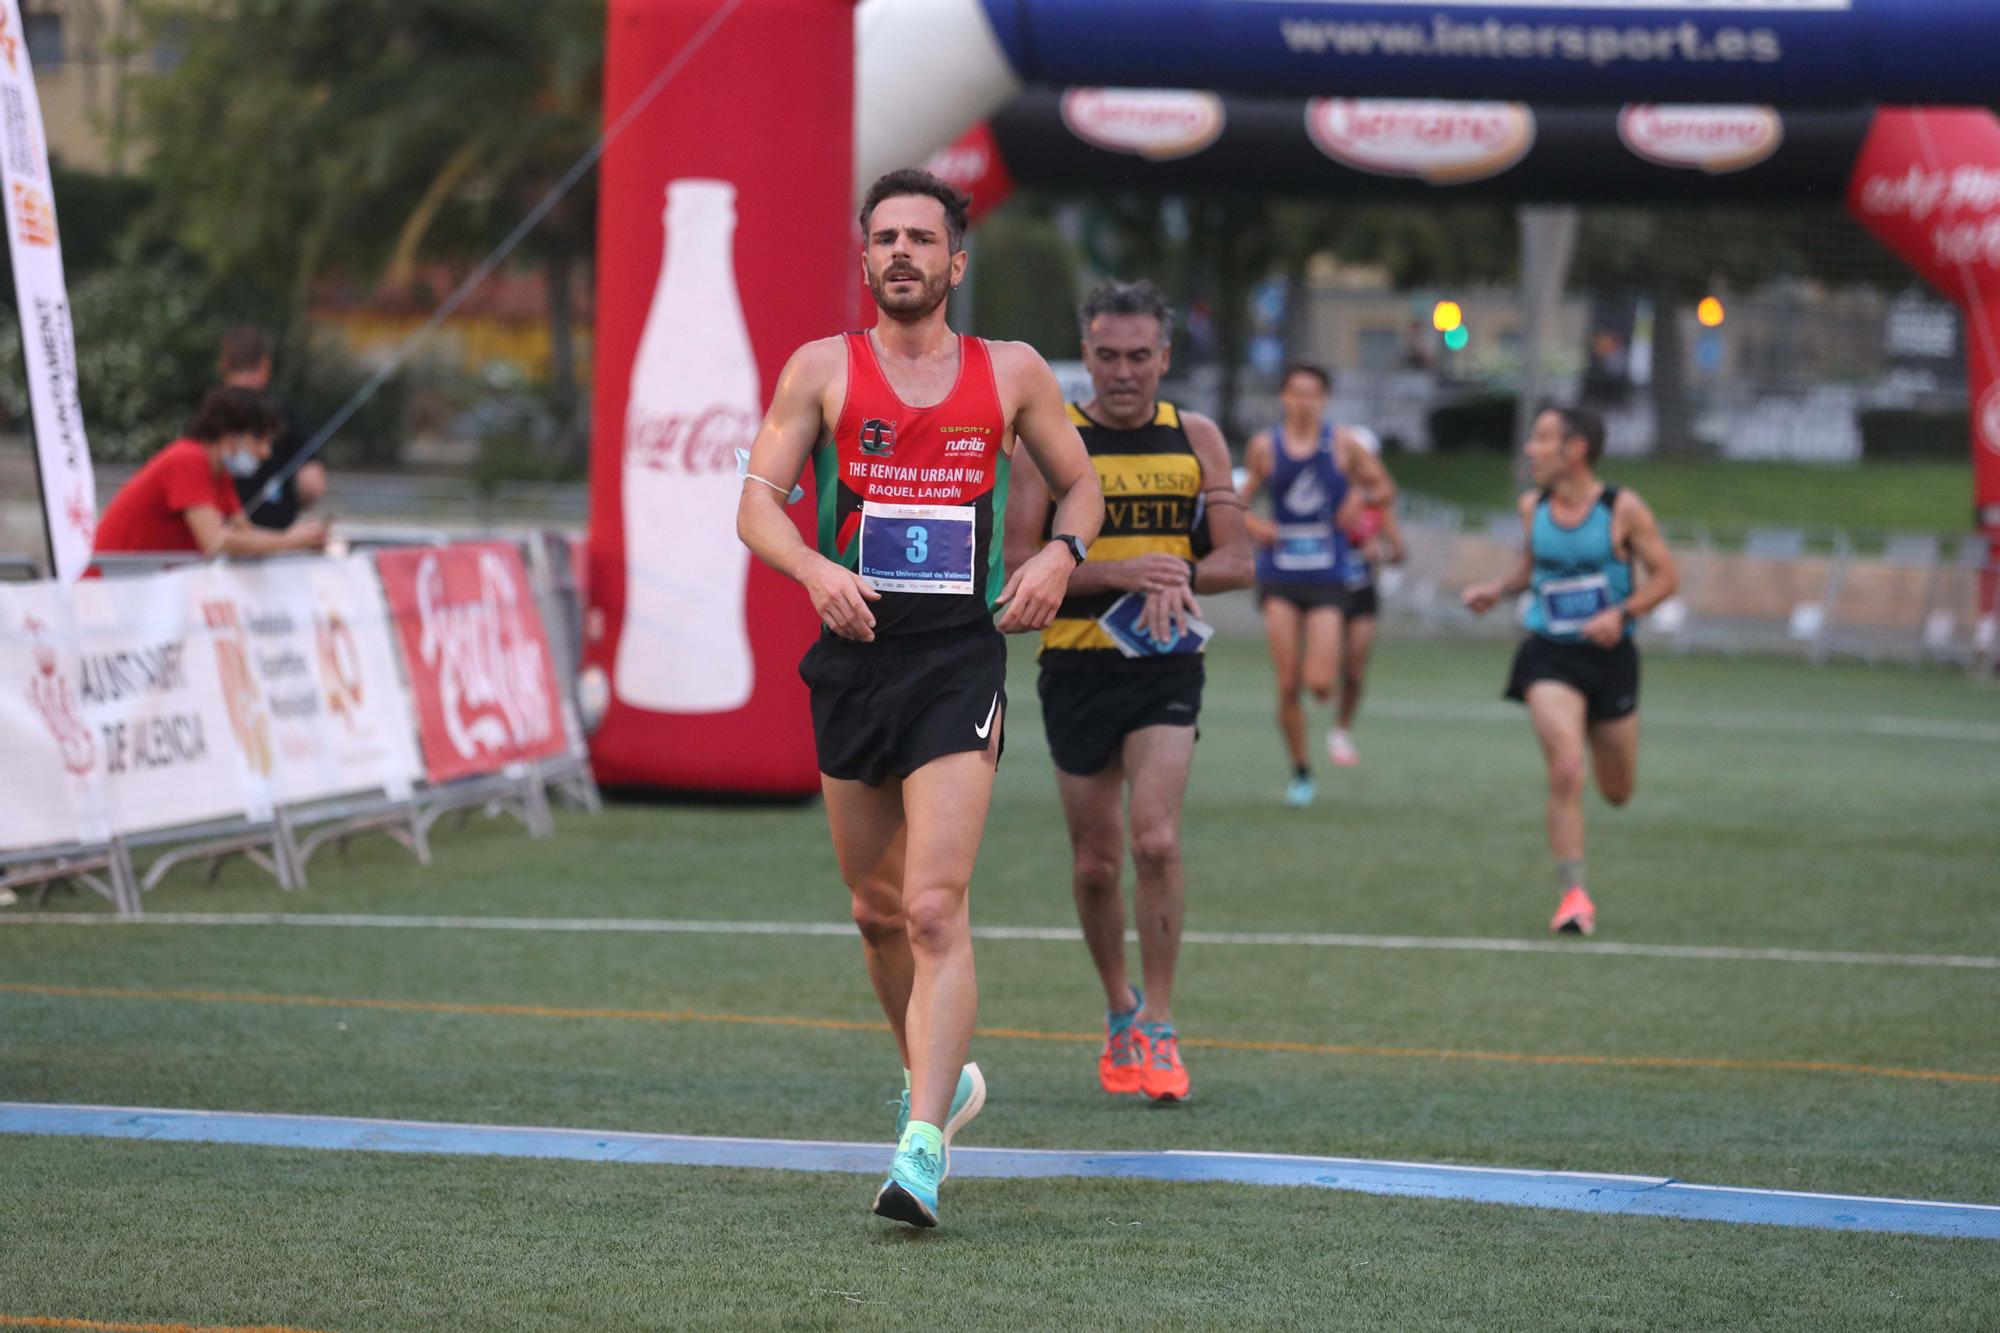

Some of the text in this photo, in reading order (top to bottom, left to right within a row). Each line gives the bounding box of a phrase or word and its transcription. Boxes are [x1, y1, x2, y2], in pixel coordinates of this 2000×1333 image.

[1281, 15, 1781, 65] www.intersport.es
[849, 462, 868, 477] THE
[870, 463, 917, 482] KENYAN
[920, 467, 963, 482] URBAN
[868, 484, 962, 499] RAQUEL LANDÍN
[906, 525, 928, 564] 3
